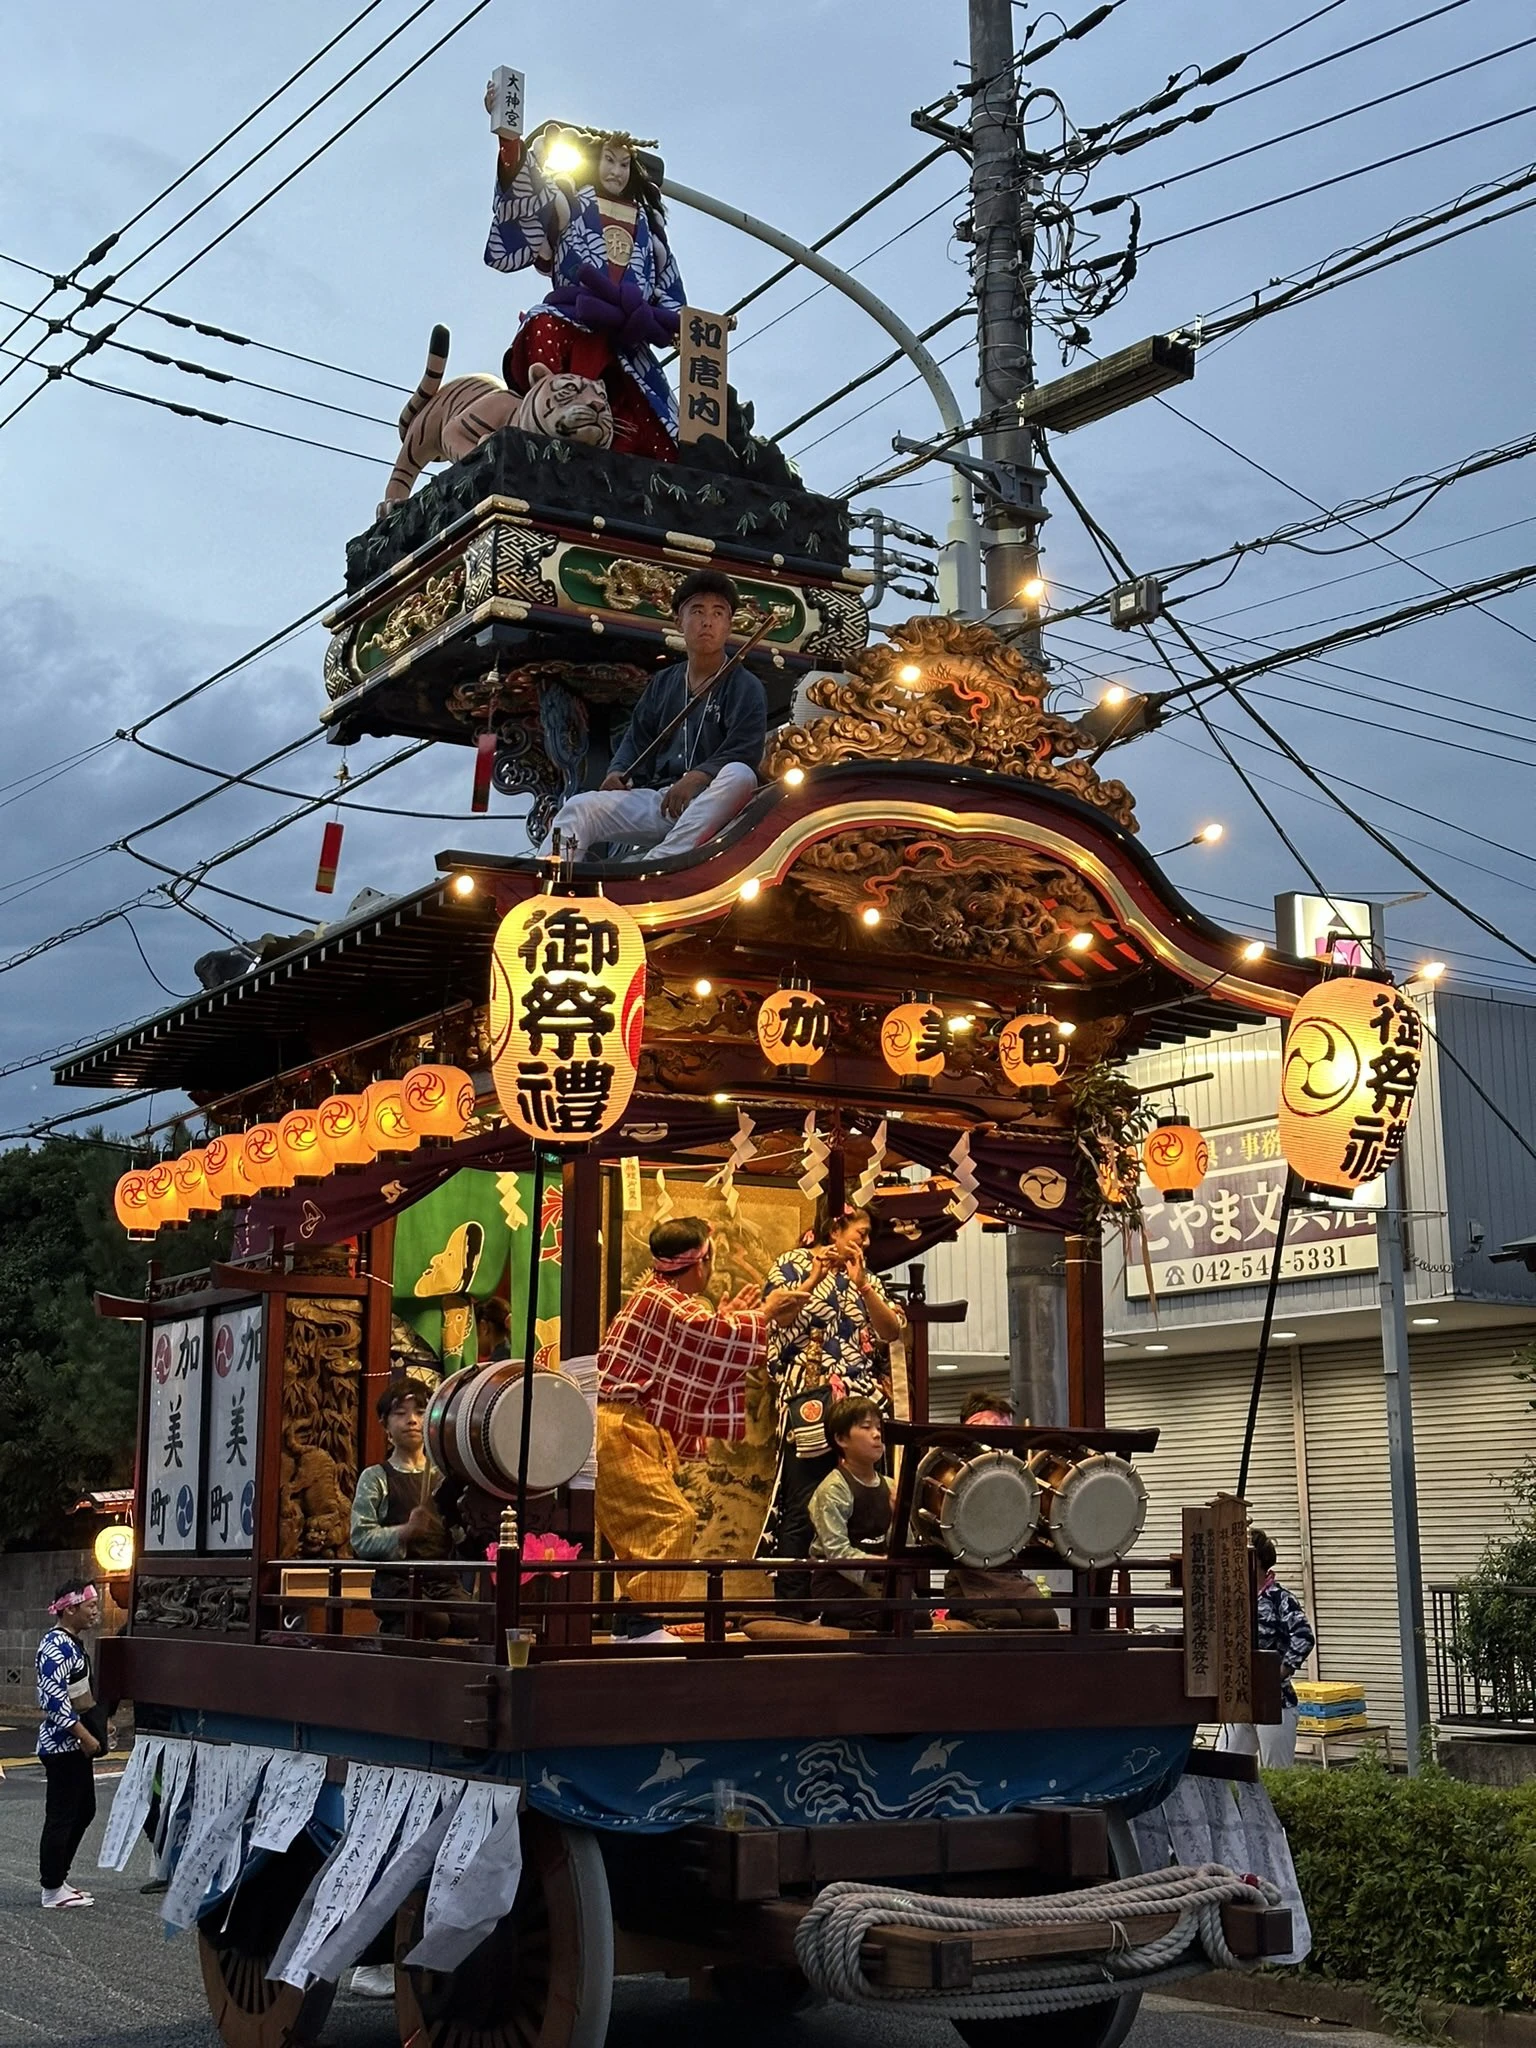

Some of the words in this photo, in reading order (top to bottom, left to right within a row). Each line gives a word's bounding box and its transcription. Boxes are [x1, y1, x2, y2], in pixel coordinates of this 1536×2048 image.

[505, 73, 521, 128] 大神宮
[688, 314, 723, 427] 和唐内
[517, 906, 620, 1134] 御祭禮
[1139, 1181, 1377, 1252] こやま文
[1192, 1244, 1348, 1285] 042-54-5331
[150, 1321, 200, 1546] 加美町
[210, 1314, 262, 1544] 加美町
